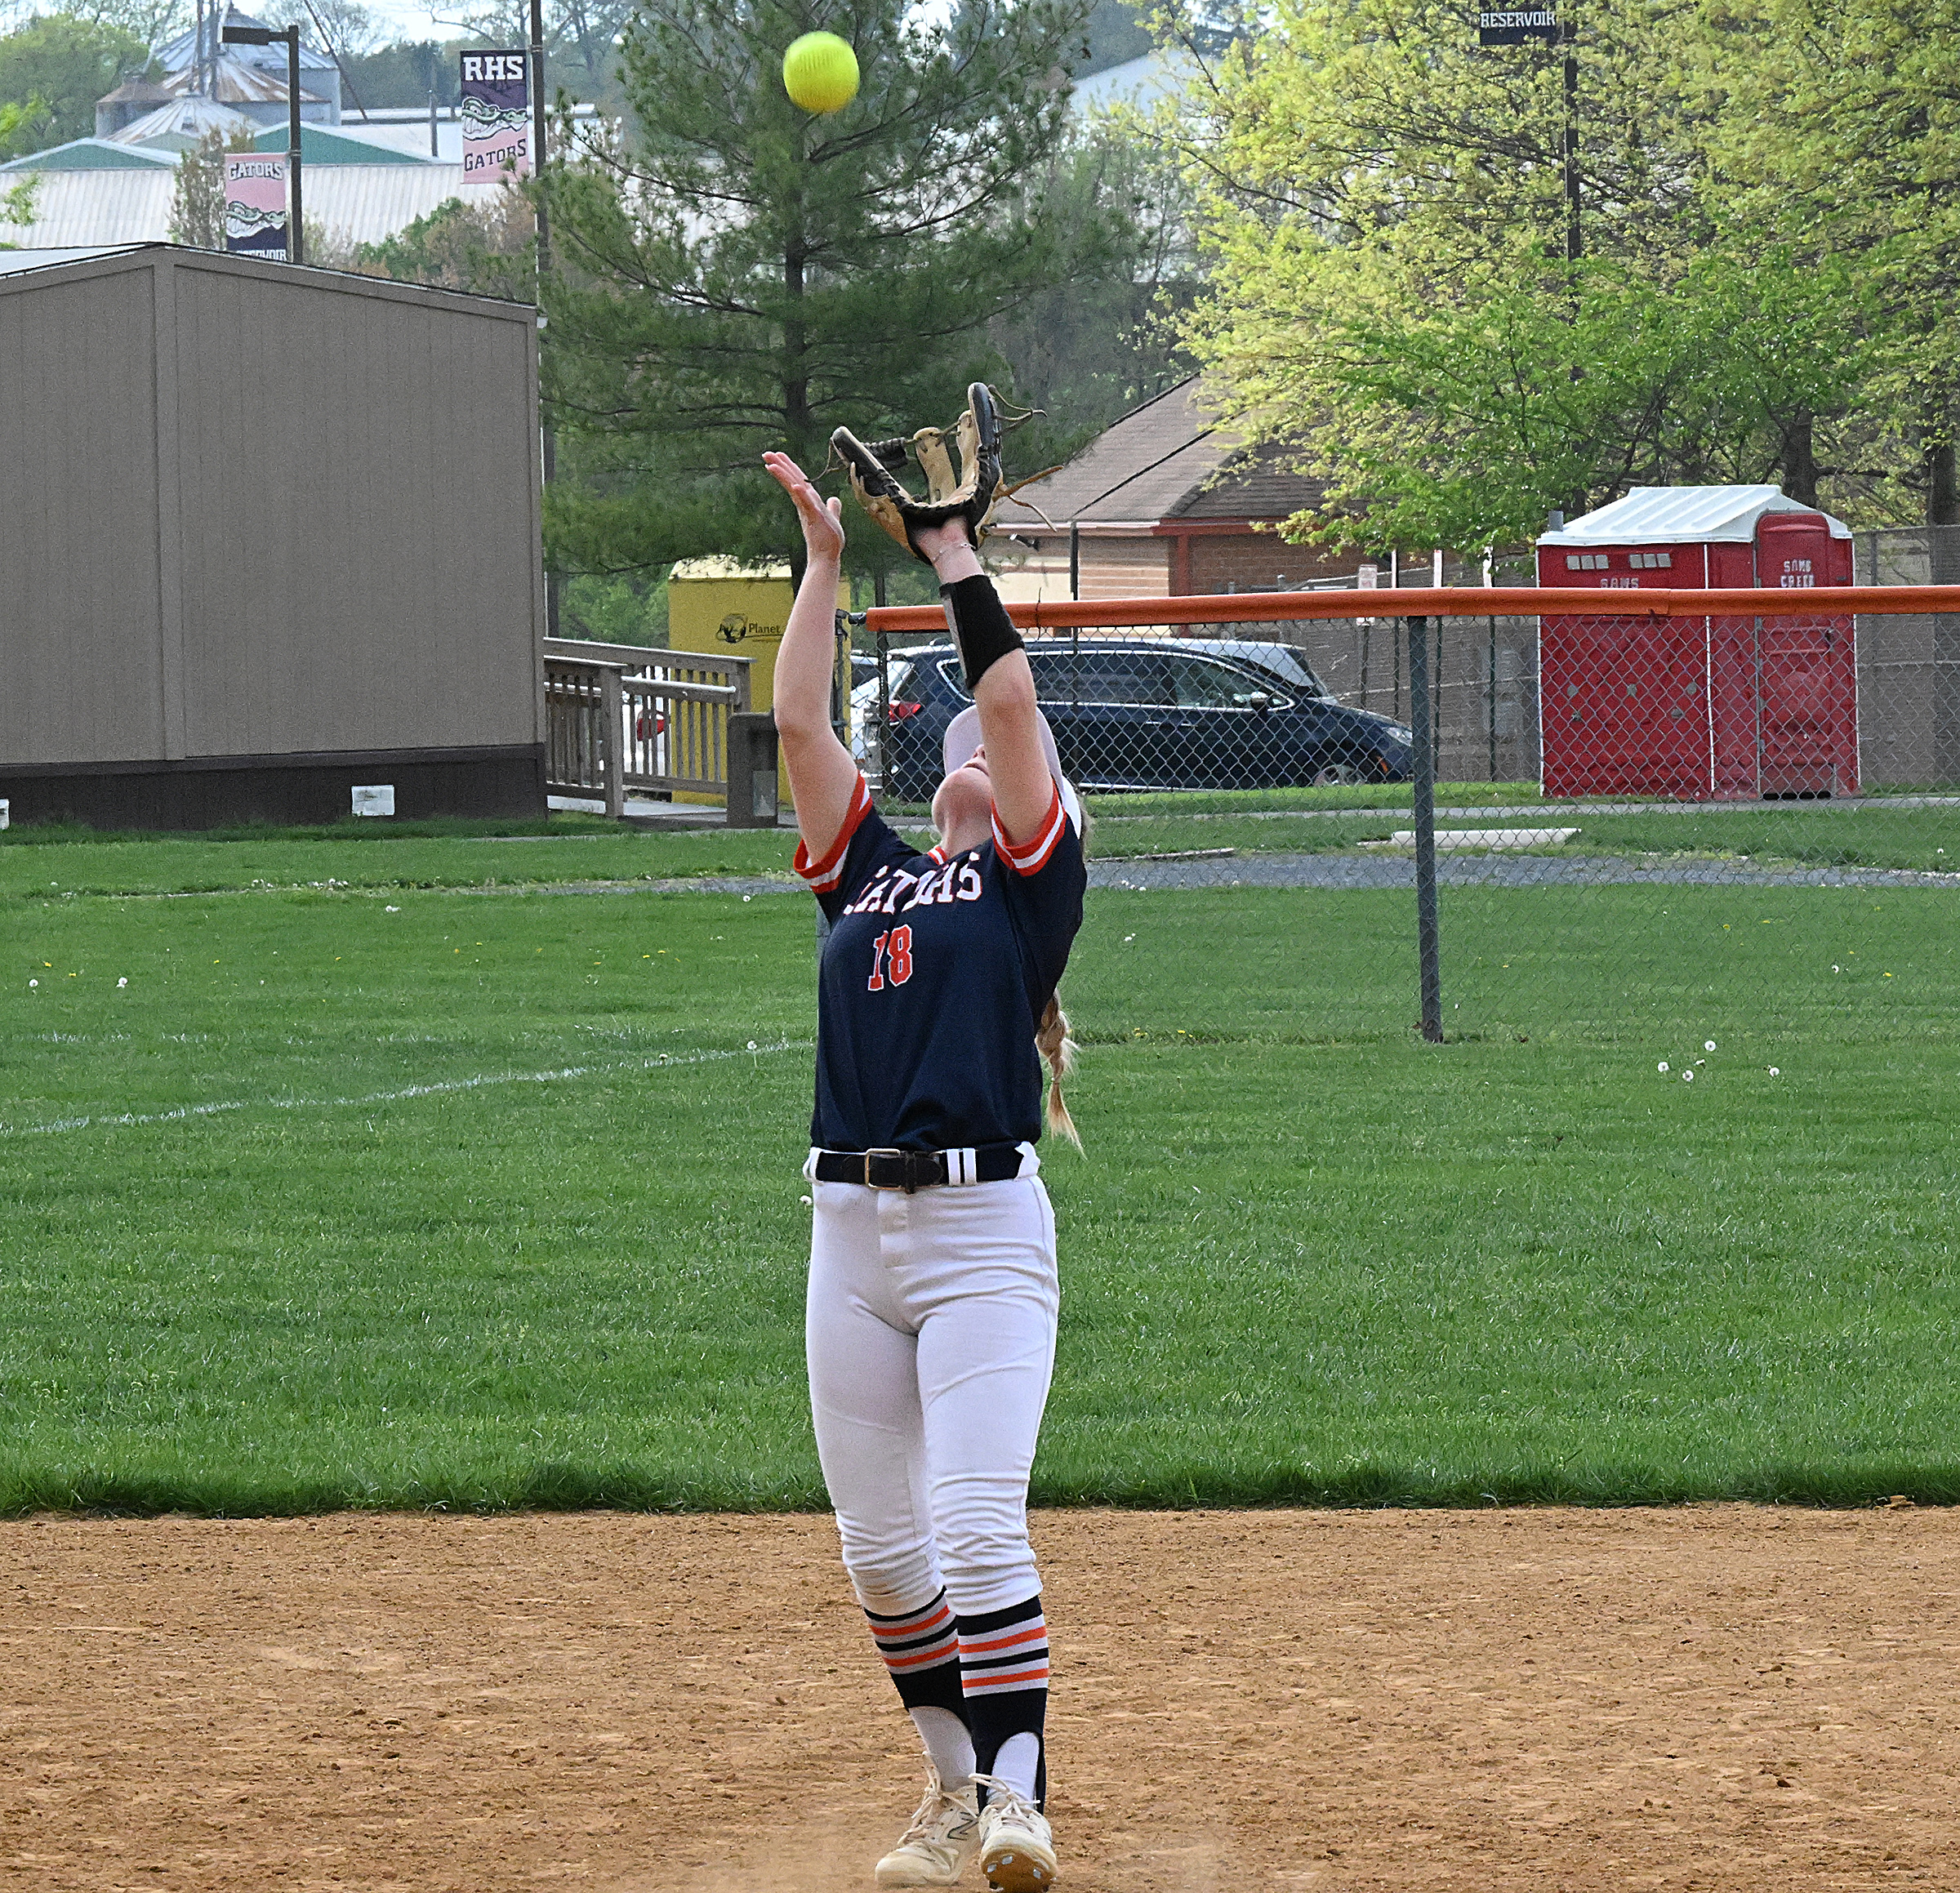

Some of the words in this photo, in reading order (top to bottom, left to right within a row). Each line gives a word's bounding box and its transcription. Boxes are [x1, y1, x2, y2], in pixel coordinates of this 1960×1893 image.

[1480, 11, 1556, 28] RESERVOIR
[463, 56, 523, 81] RHS
[464, 138, 527, 171] GATORS
[228, 162, 284, 180] GATORS
[748, 622, 781, 634] Planet
[867, 924, 913, 991] 18
